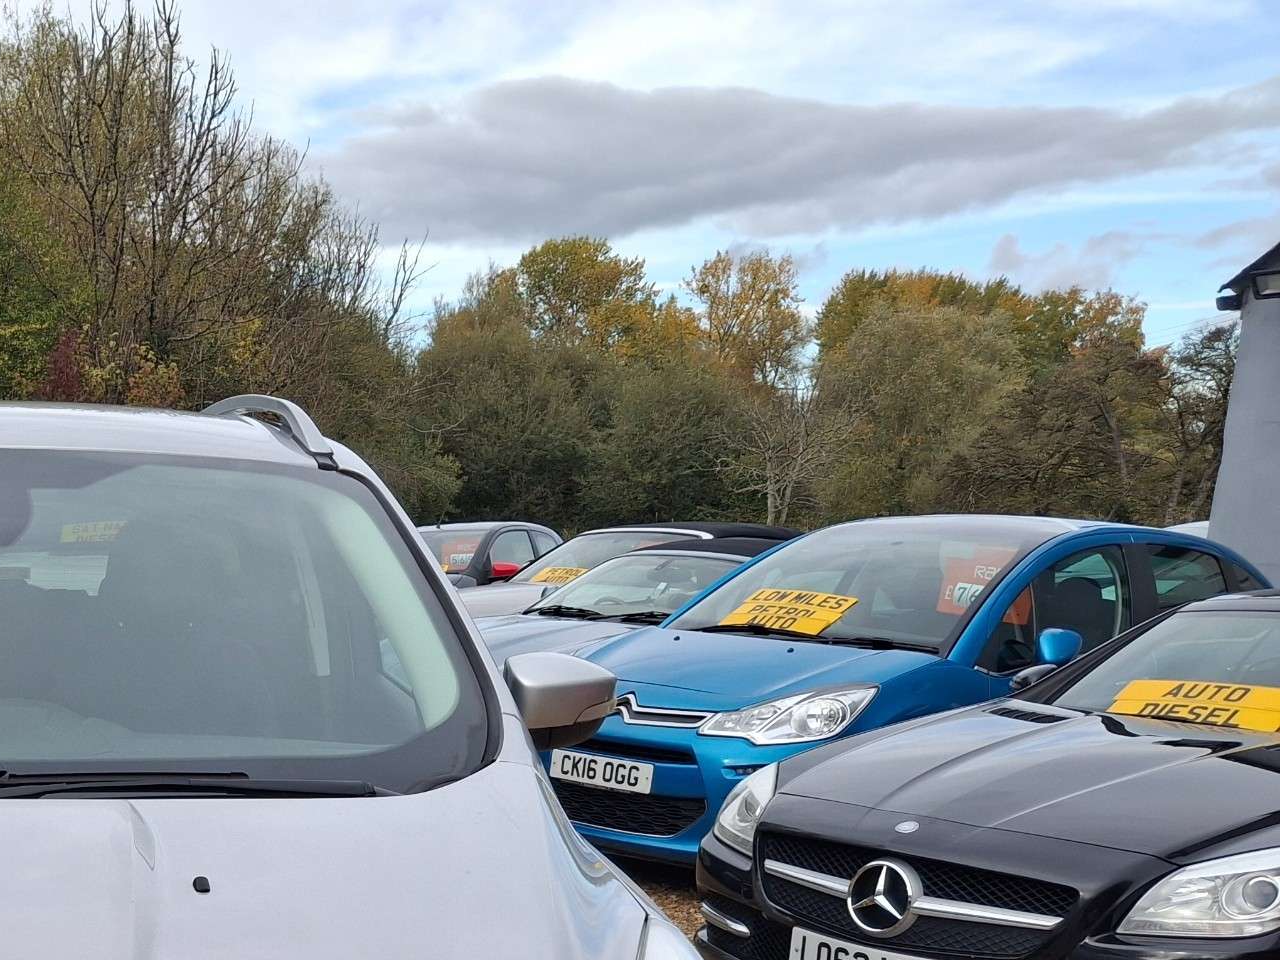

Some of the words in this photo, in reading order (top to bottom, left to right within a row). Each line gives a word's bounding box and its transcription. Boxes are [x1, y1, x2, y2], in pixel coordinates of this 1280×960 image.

[752, 590, 794, 603] LOW
[788, 592, 848, 610] MILES
[746, 614, 798, 629] AUTO
[1161, 683, 1251, 703] AUTO
[1138, 702, 1240, 728] DIESEL
[560, 754, 598, 780] CK16
[602, 761, 640, 787] OGG
